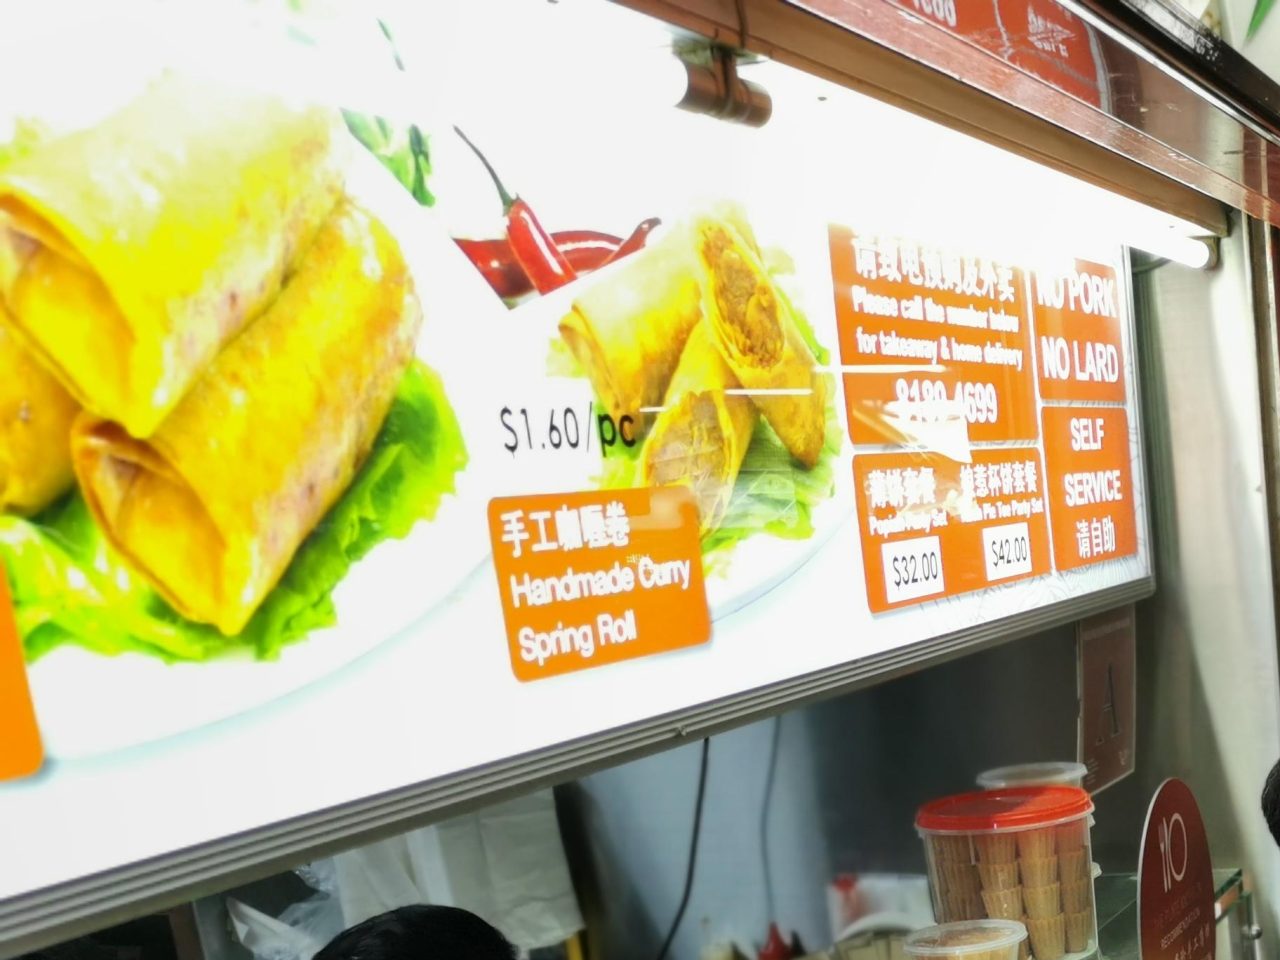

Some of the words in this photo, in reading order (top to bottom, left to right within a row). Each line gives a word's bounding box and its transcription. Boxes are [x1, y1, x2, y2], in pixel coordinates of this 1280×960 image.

[852, 285, 898, 317] Please
[901, 295, 924, 320] call
[924, 297, 945, 323] the
[946, 304, 988, 329] number
[989, 307, 1019, 333] below
[1067, 271, 1118, 319] PORK
[856, 326, 878, 355] for
[879, 330, 938, 366] takeaway
[940, 335, 950, 360] &
[951, 337, 983, 363] home
[983, 341, 1023, 372] delivery
[1041, 335, 1071, 380] NO
[1073, 340, 1119, 383] LARD
[500, 401, 637, 458] $1.60/pc
[1070, 417, 1105, 451] SELF
[1064, 469, 1122, 507] SERVICE
[992, 536, 1028, 567] $42.00
[1076, 515, 1115, 559] 请自助
[510, 562, 634, 608] Handmade
[638, 557, 690, 590] Curry
[892, 552, 938, 590] $32.00
[518, 621, 594, 666] Spring
[597, 608, 637, 646] Roll
